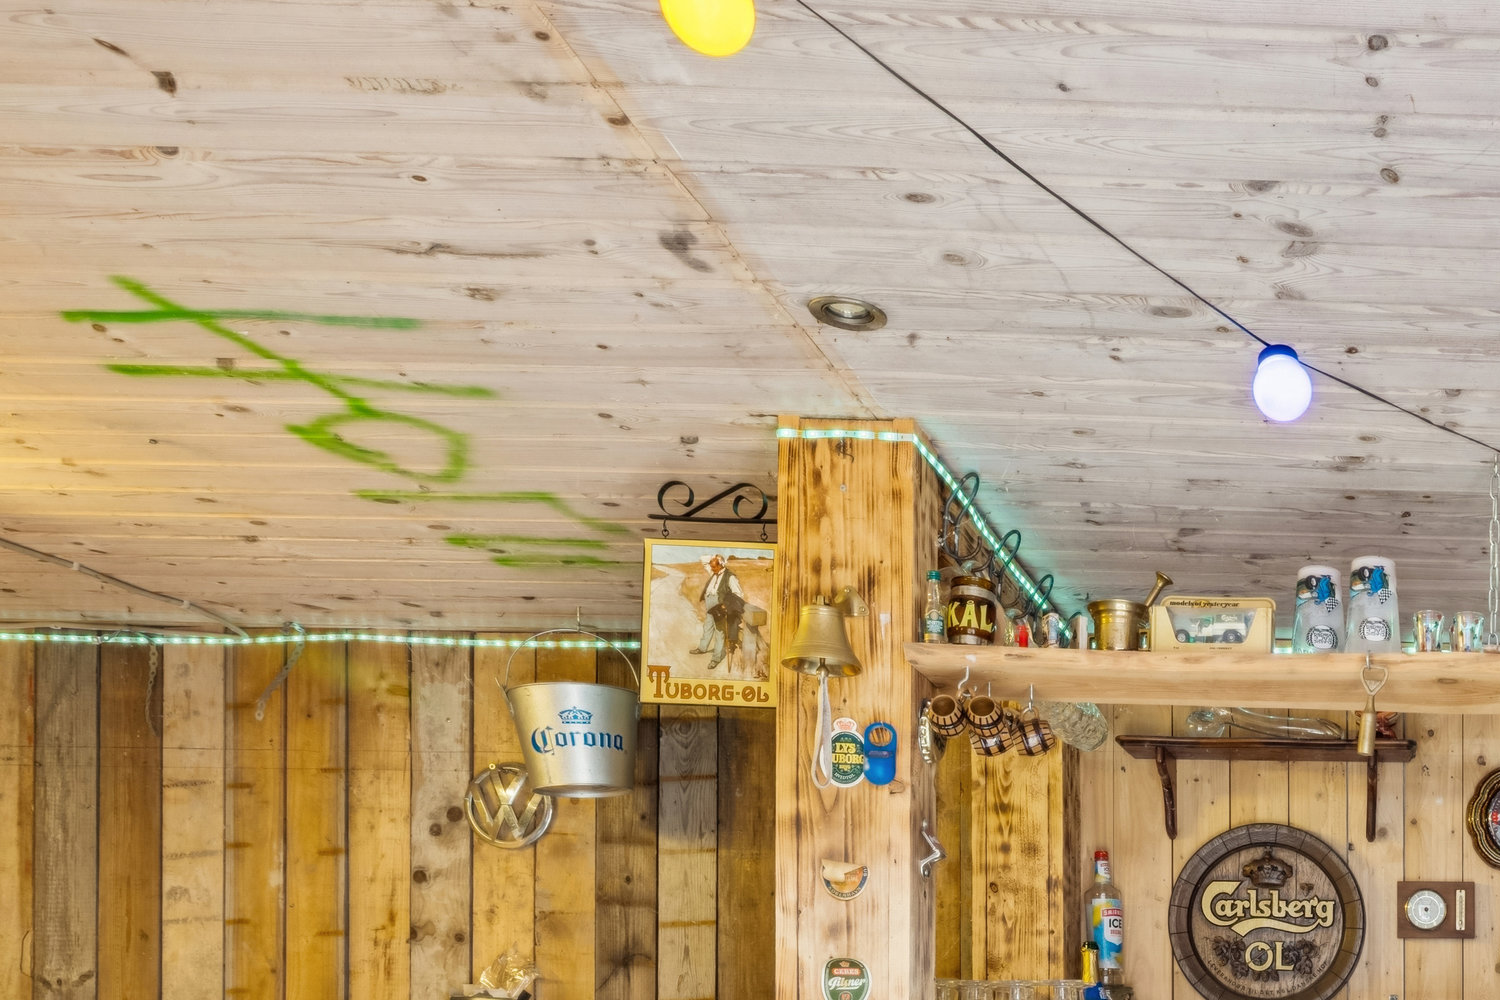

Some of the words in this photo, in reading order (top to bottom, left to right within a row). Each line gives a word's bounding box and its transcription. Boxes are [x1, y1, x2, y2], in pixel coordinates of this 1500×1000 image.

[947, 600, 993, 631] KÅL
[647, 664, 770, 703] TUBORG-ØL
[531, 725, 625, 756] Corona
[835, 742, 856, 753] LYS
[831, 753, 864, 765] UBORG
[1201, 879, 1336, 928] Carlsberg
[828, 976, 867, 991] Pilsner
